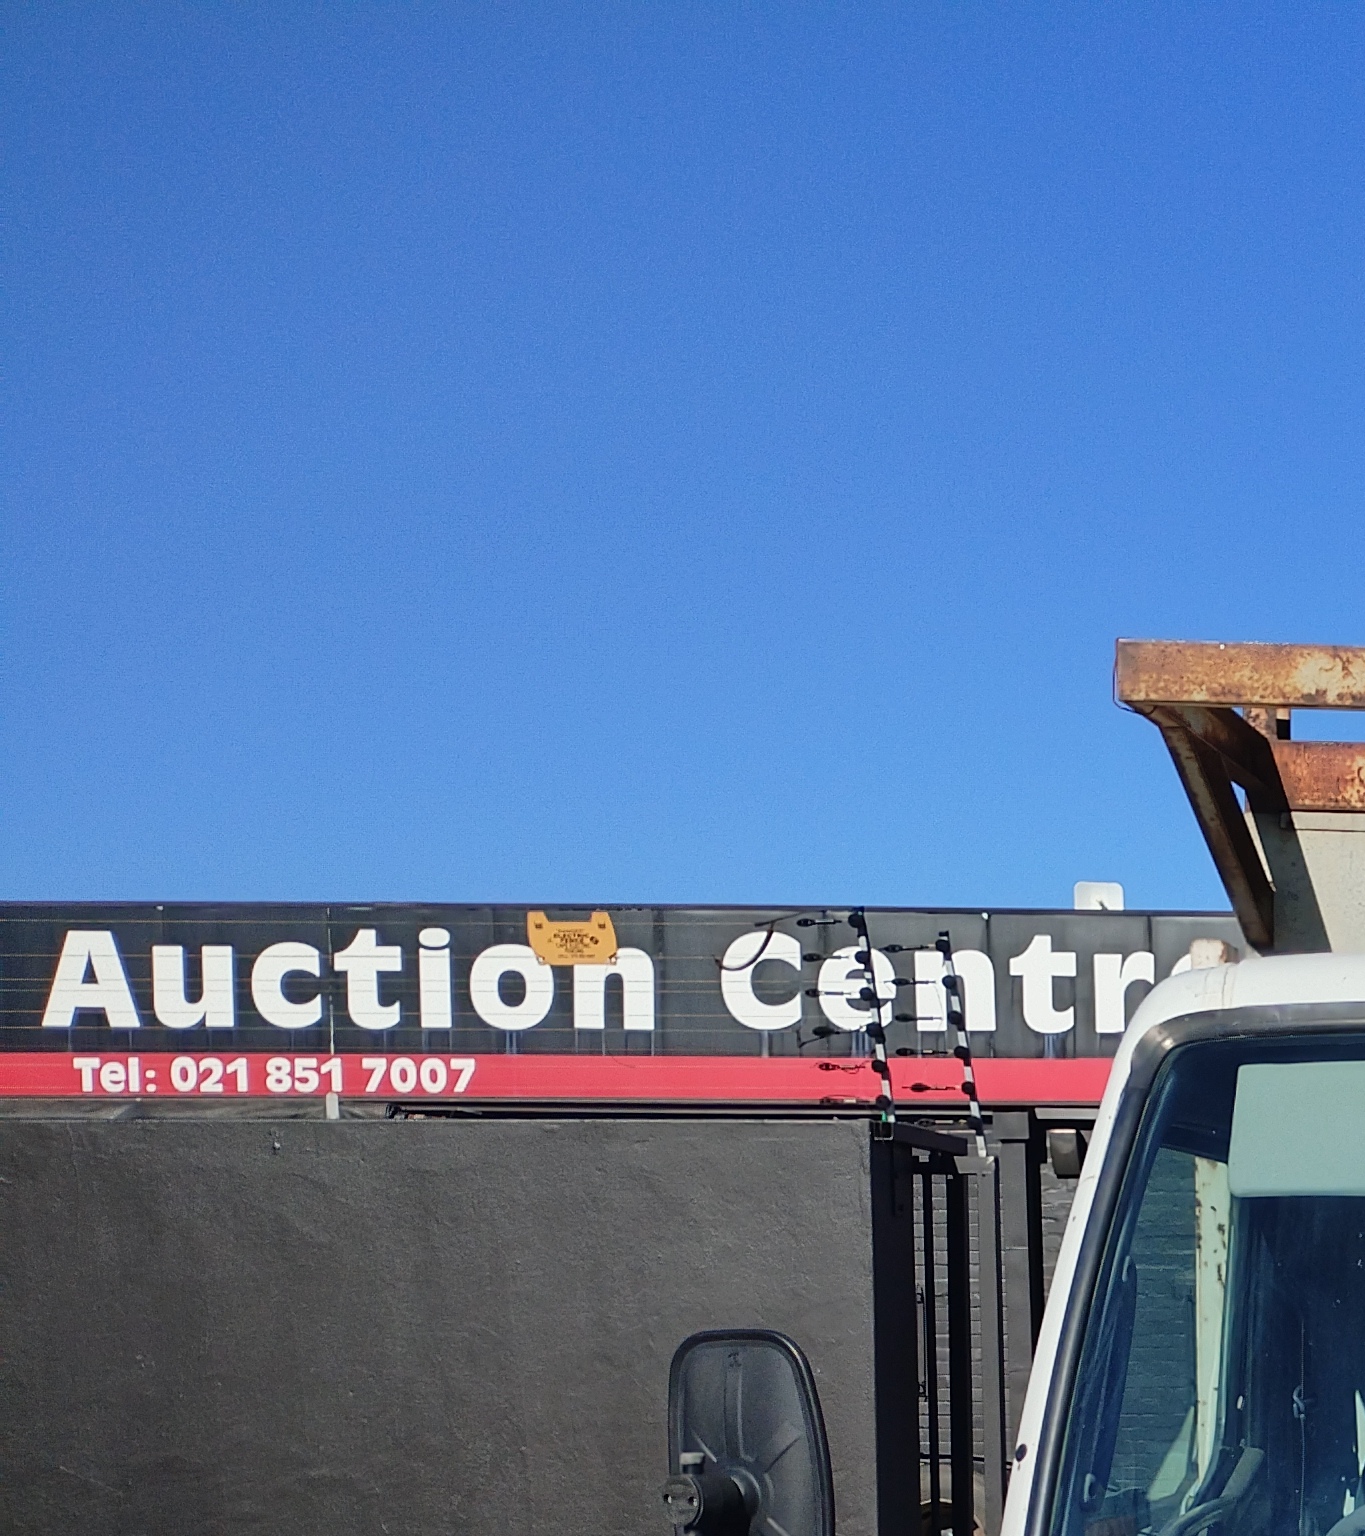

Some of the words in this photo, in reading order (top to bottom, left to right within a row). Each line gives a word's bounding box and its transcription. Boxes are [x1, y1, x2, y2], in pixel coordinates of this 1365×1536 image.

[42, 927, 656, 1031] Auction
[720, 930, 1192, 1034] Centr
[73, 1057, 157, 1093] Tel:
[170, 1057, 248, 1094] 021
[265, 1057, 343, 1093] 851
[362, 1058, 477, 1093] 7007
